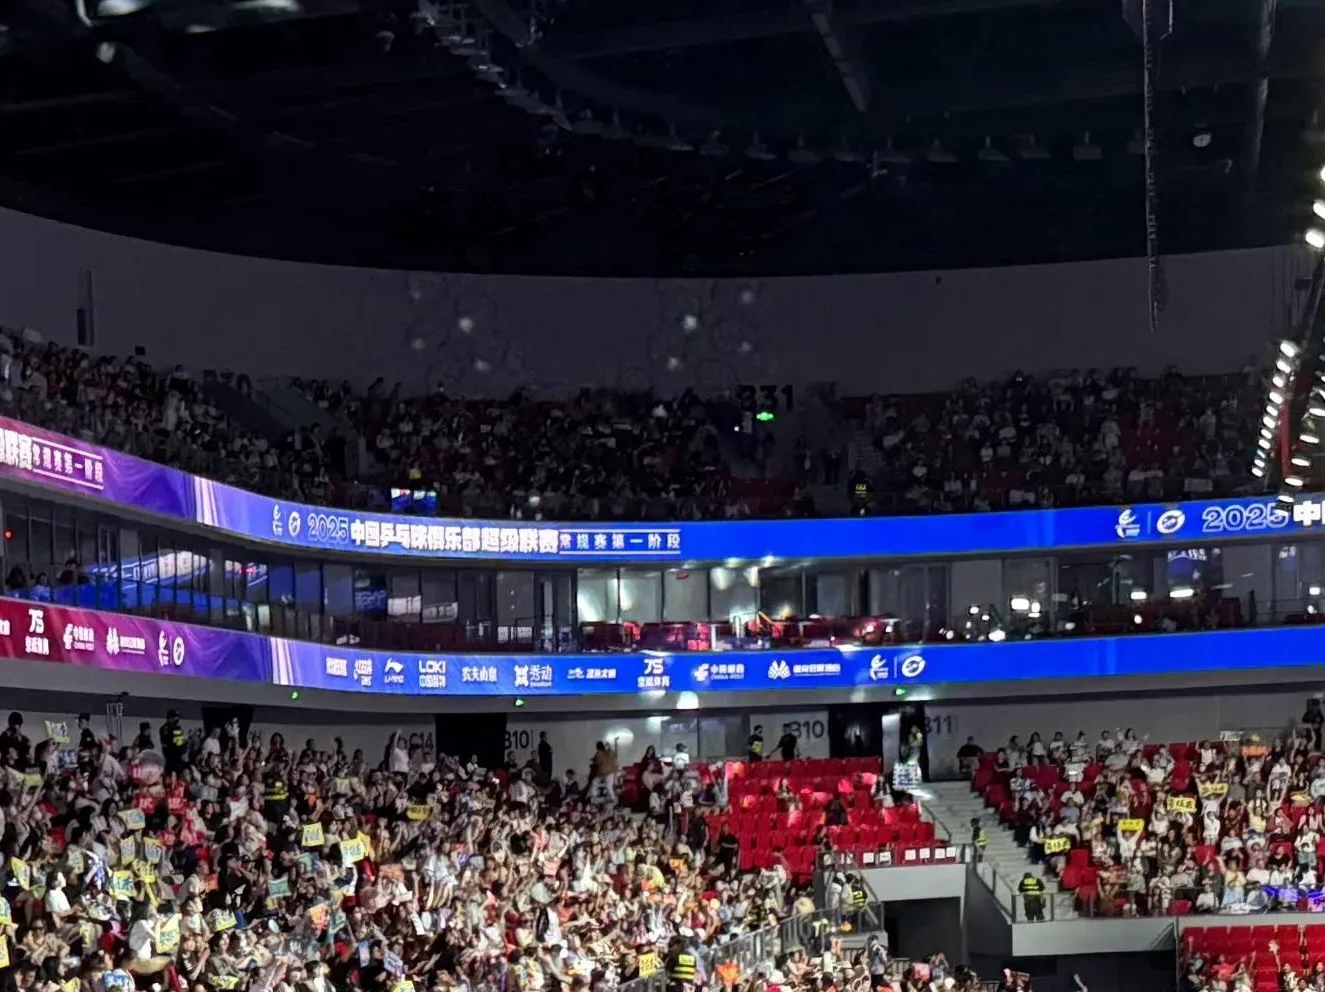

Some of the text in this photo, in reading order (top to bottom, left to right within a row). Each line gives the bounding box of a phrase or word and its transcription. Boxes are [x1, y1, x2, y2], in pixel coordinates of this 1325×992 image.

[1202, 500, 1325, 533] 2025 中
[307, 513, 350, 543] 2025
[350, 518, 558, 555] 中国乒乓球俱乐部超级联赛
[419, 661, 446, 674] LOKI
[462, 665, 497, 684] 农夫山泉
[529, 664, 552, 681] 秀动
